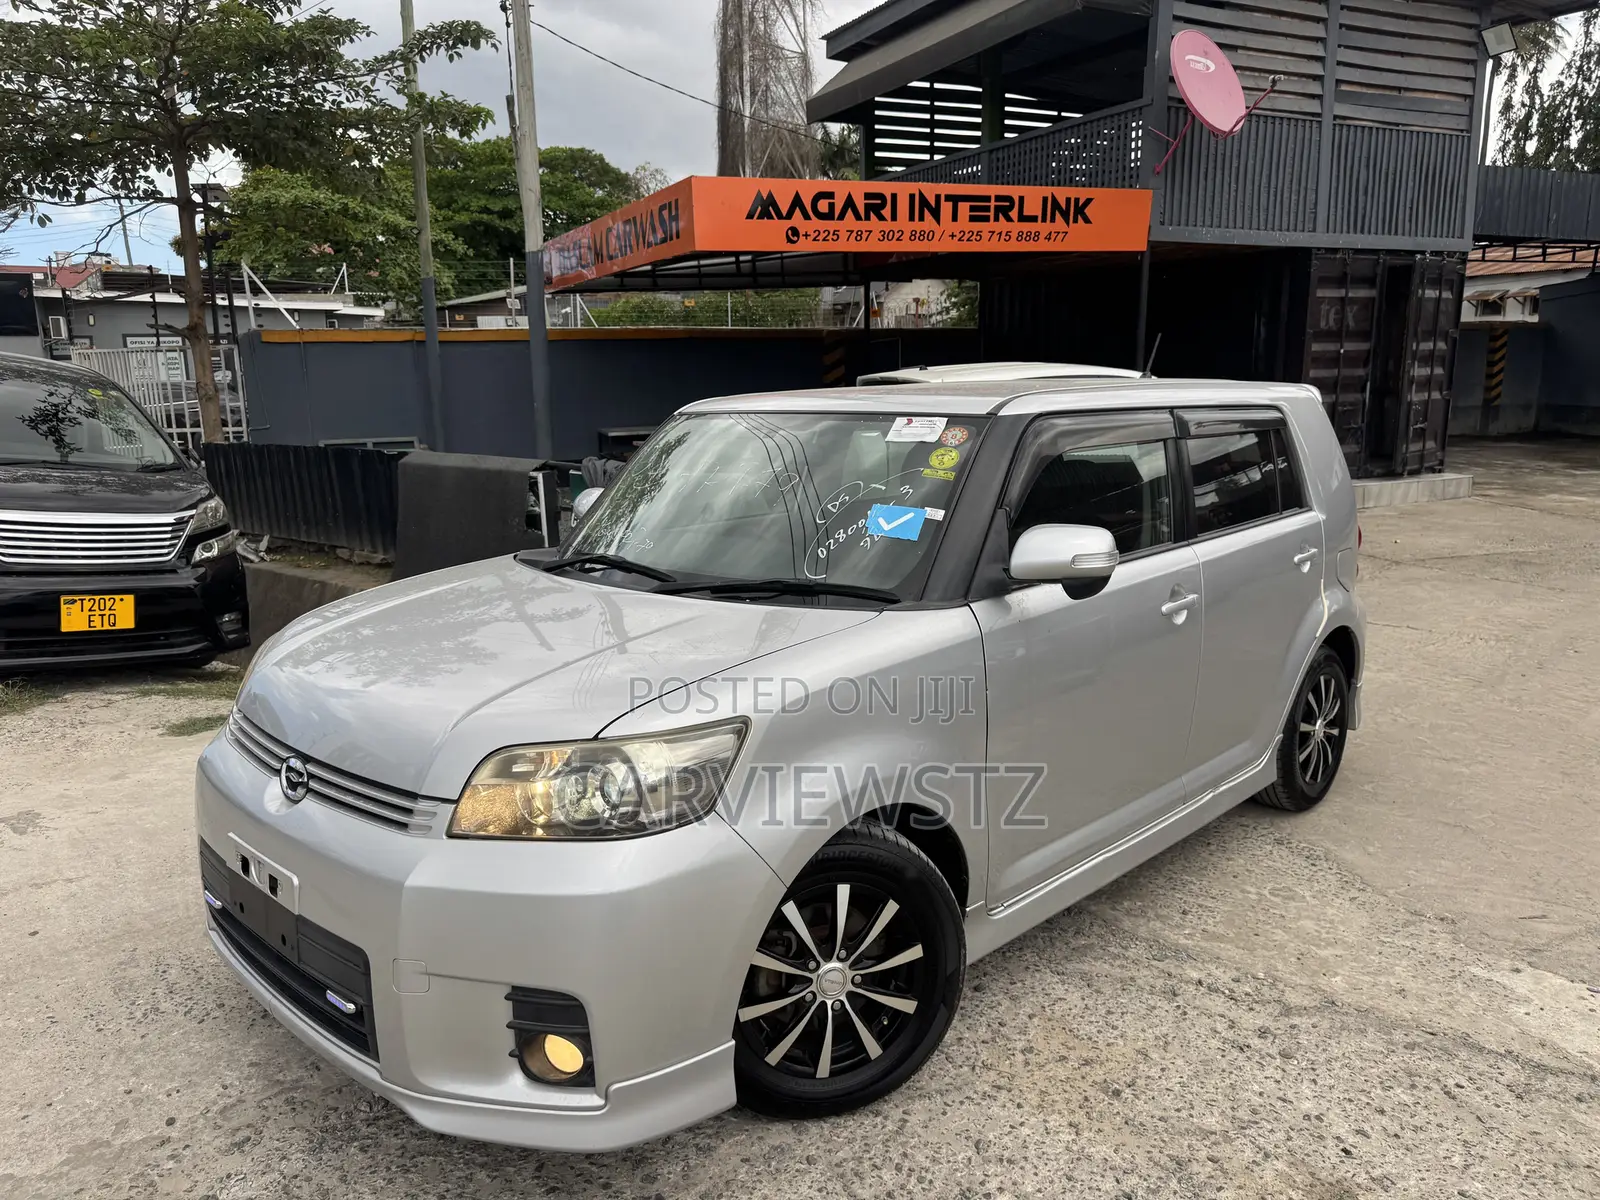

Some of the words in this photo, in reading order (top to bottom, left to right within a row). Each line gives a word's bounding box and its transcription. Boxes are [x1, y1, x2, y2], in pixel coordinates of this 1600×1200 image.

[745, 189, 898, 222] MAGARI
[909, 188, 1095, 228] INTERLINK
[605, 198, 680, 261] CARWASH
[802, 230, 840, 242] +225
[846, 230, 872, 242] 787
[878, 230, 904, 242] 302
[909, 230, 935, 242] 880
[938, 230, 945, 242] /
[949, 231, 983, 242] +225
[988, 231, 1012, 242] 715
[1016, 231, 1041, 243] 888
[1044, 231, 1069, 243] 477
[77, 597, 117, 612] T202
[87, 613, 117, 628] ETQ
